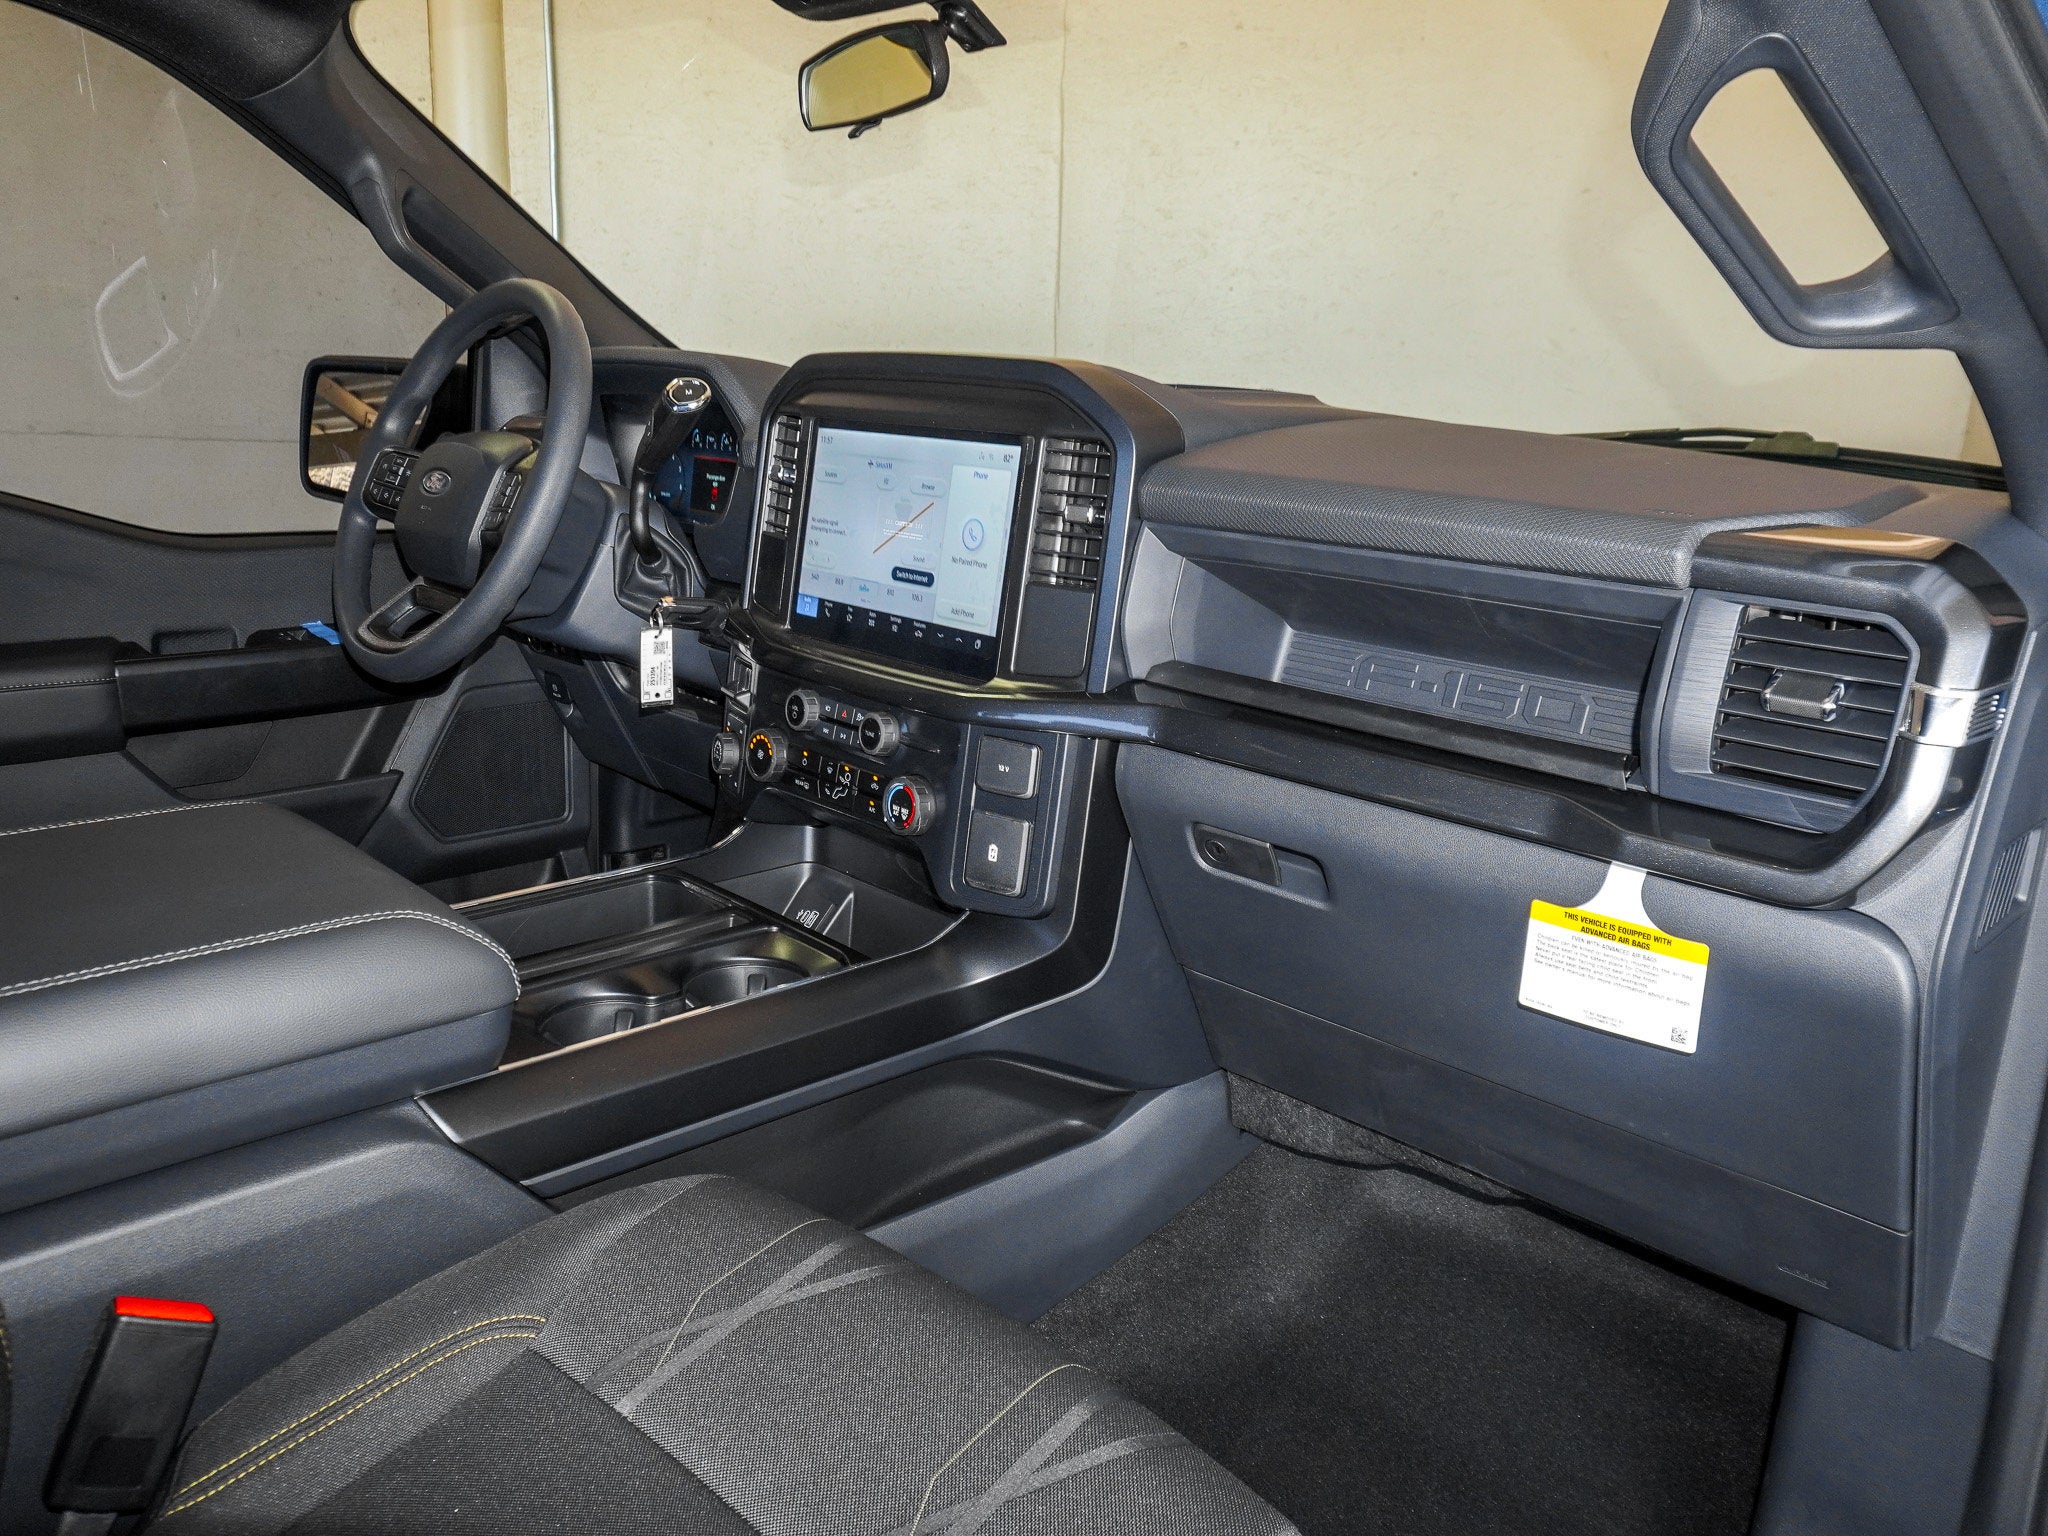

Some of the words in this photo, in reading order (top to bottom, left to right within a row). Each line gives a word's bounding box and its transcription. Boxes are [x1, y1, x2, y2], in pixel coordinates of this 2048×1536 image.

[973, 470, 989, 480] Phone
[973, 560, 987, 569] Phone
[959, 609, 975, 618] Phone
[1563, 911, 1578, 921] THIS
[1580, 916, 1606, 929] VEHICLE
[1608, 923, 1615, 931] IS
[1617, 925, 1651, 941] EQUIPPED
[1653, 935, 1672, 946] WITH
[1580, 925, 1616, 941] ADVANCED
[1618, 936, 1629, 945] AIR
[1631, 939, 1650, 950] BAGS
[1601, 943, 1629, 955] ADVANCED
